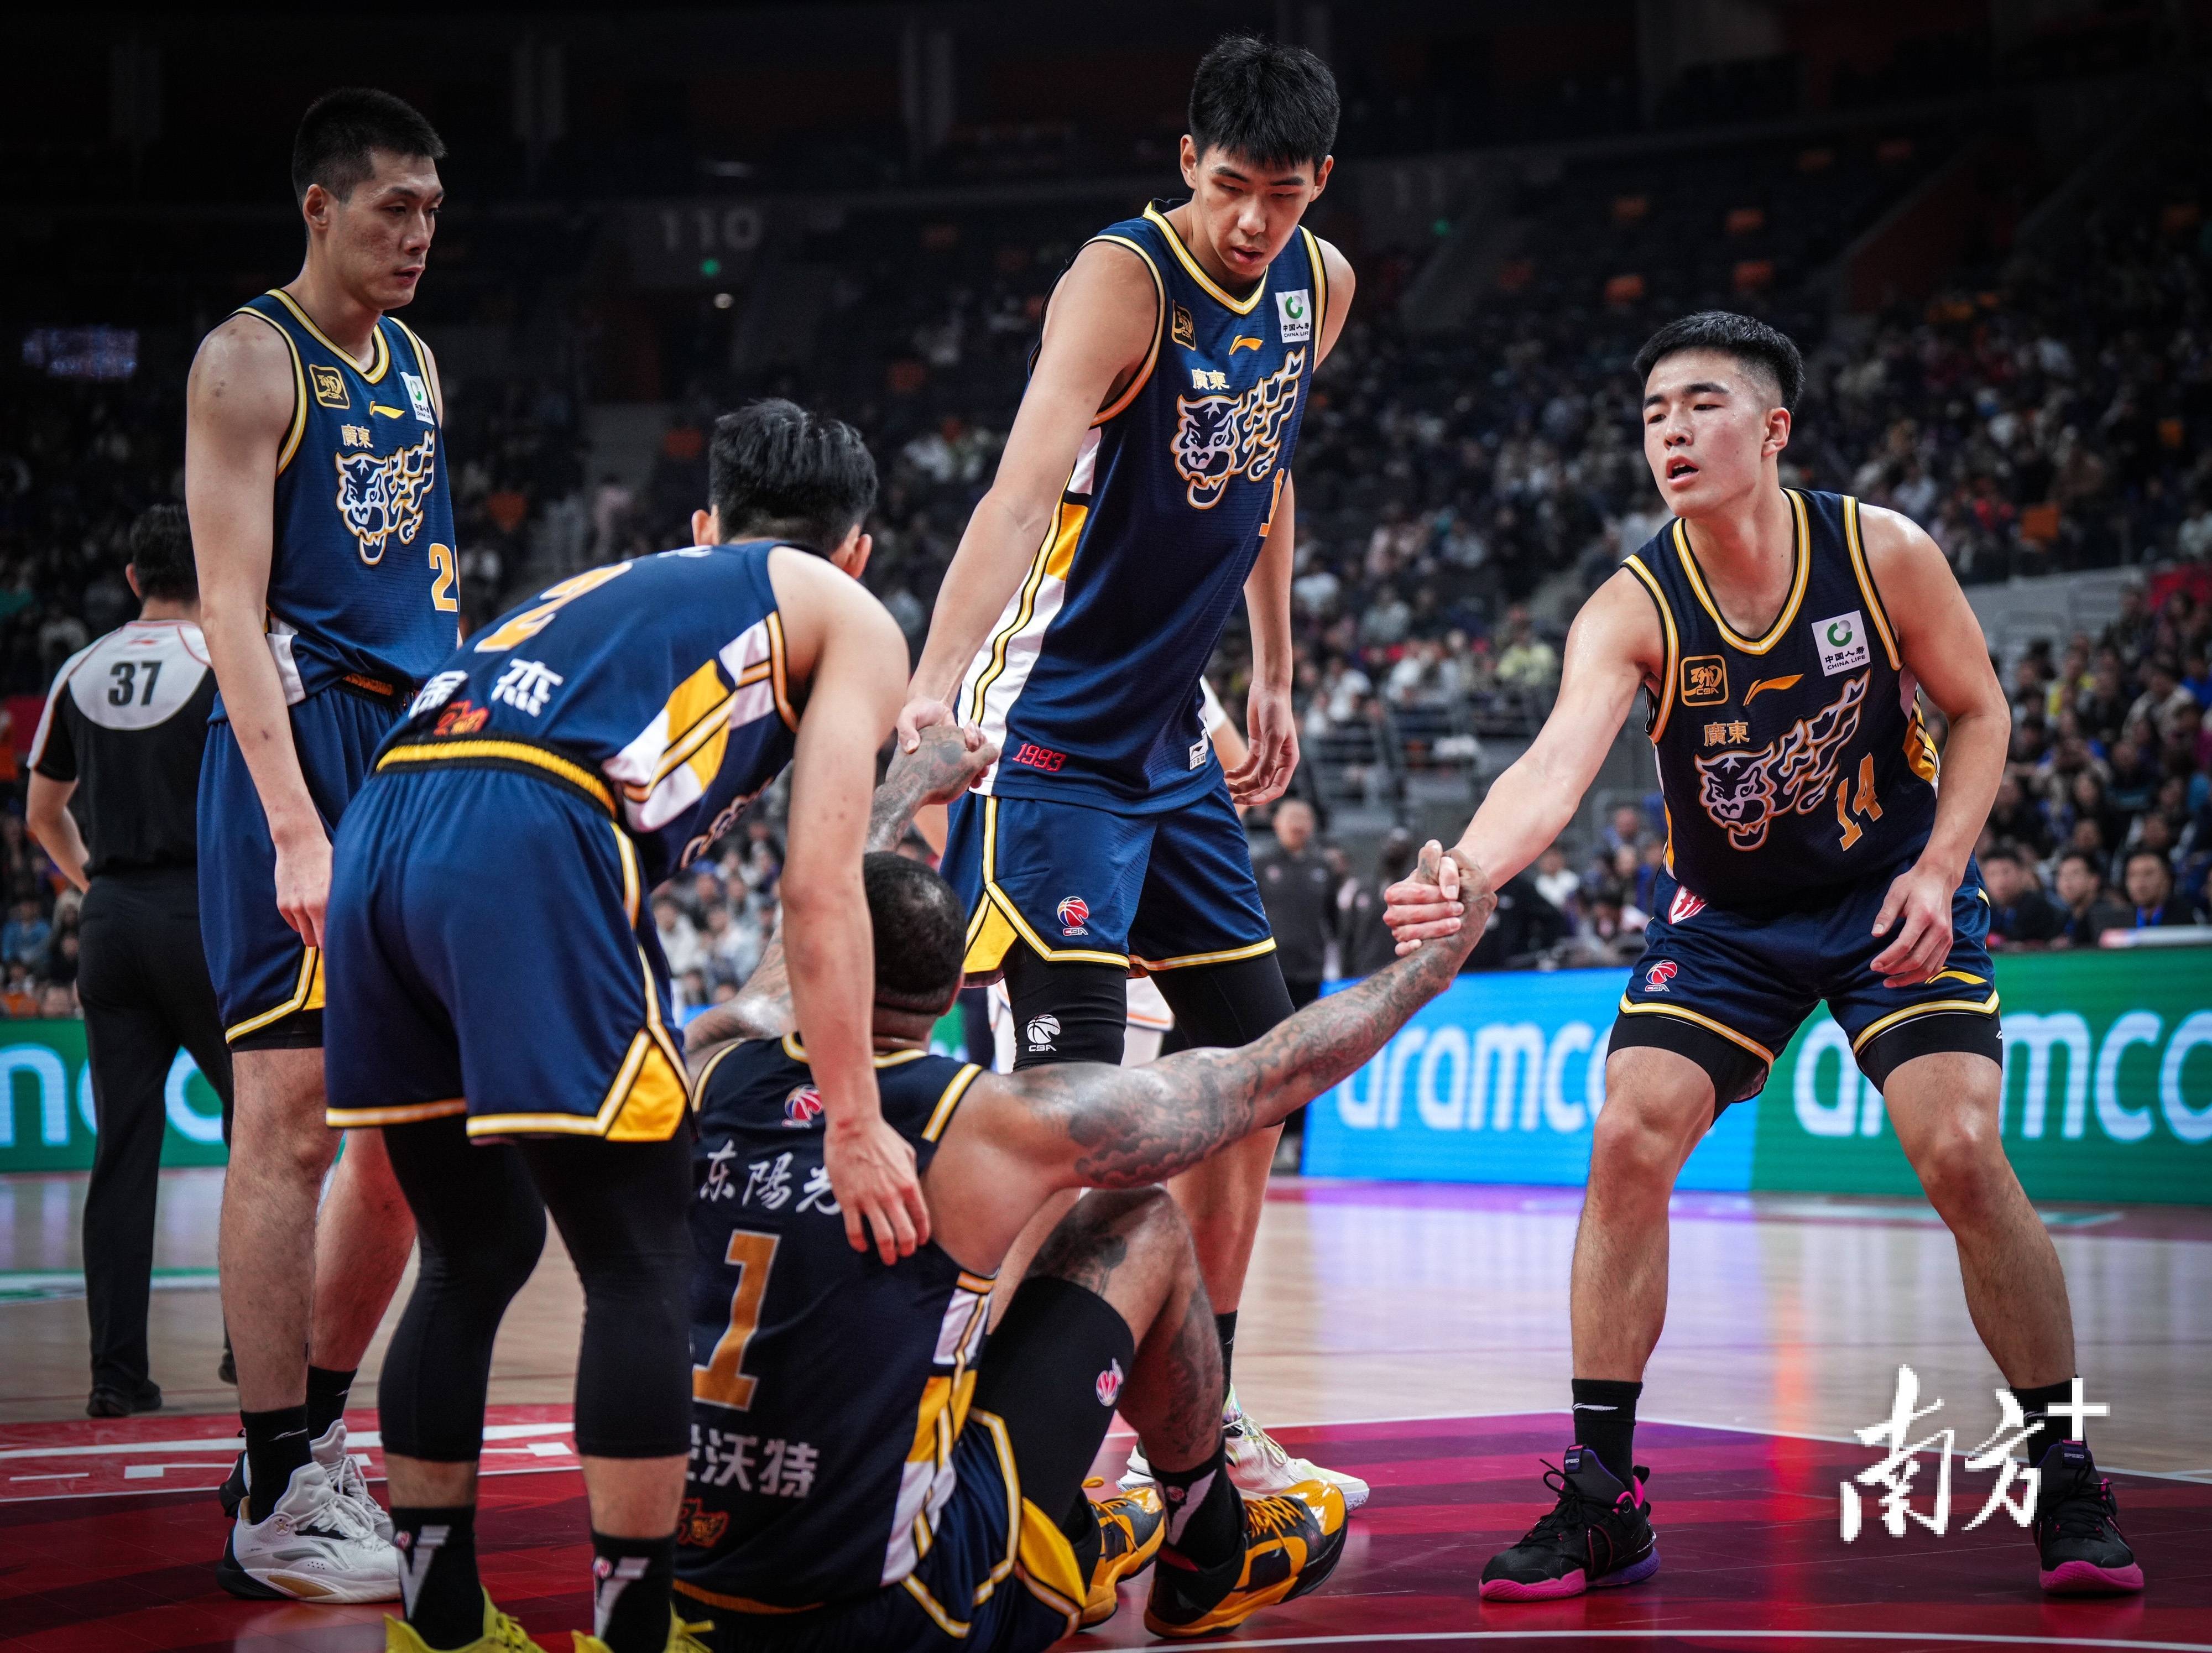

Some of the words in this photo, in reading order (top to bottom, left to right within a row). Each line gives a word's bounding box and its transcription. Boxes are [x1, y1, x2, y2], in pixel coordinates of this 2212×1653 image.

[661, 207, 762, 251] 110
[1283, 322, 1310, 332] 中国人寿
[1191, 368, 1230, 390] 廣東
[341, 424, 373, 448] 廣東
[428, 543, 460, 612] 2
[1825, 646, 1865, 664] 中国人寿
[1827, 660, 1850, 670] CHINA
[108, 660, 162, 706] 37
[1703, 719, 1750, 747] 廣東
[1012, 743, 1067, 772] 1993
[1835, 752, 1884, 852] 14
[1063, 927, 1088, 936] CBA
[1793, 1009, 2212, 1144] amco
[692, 1228, 782, 1411] 1
